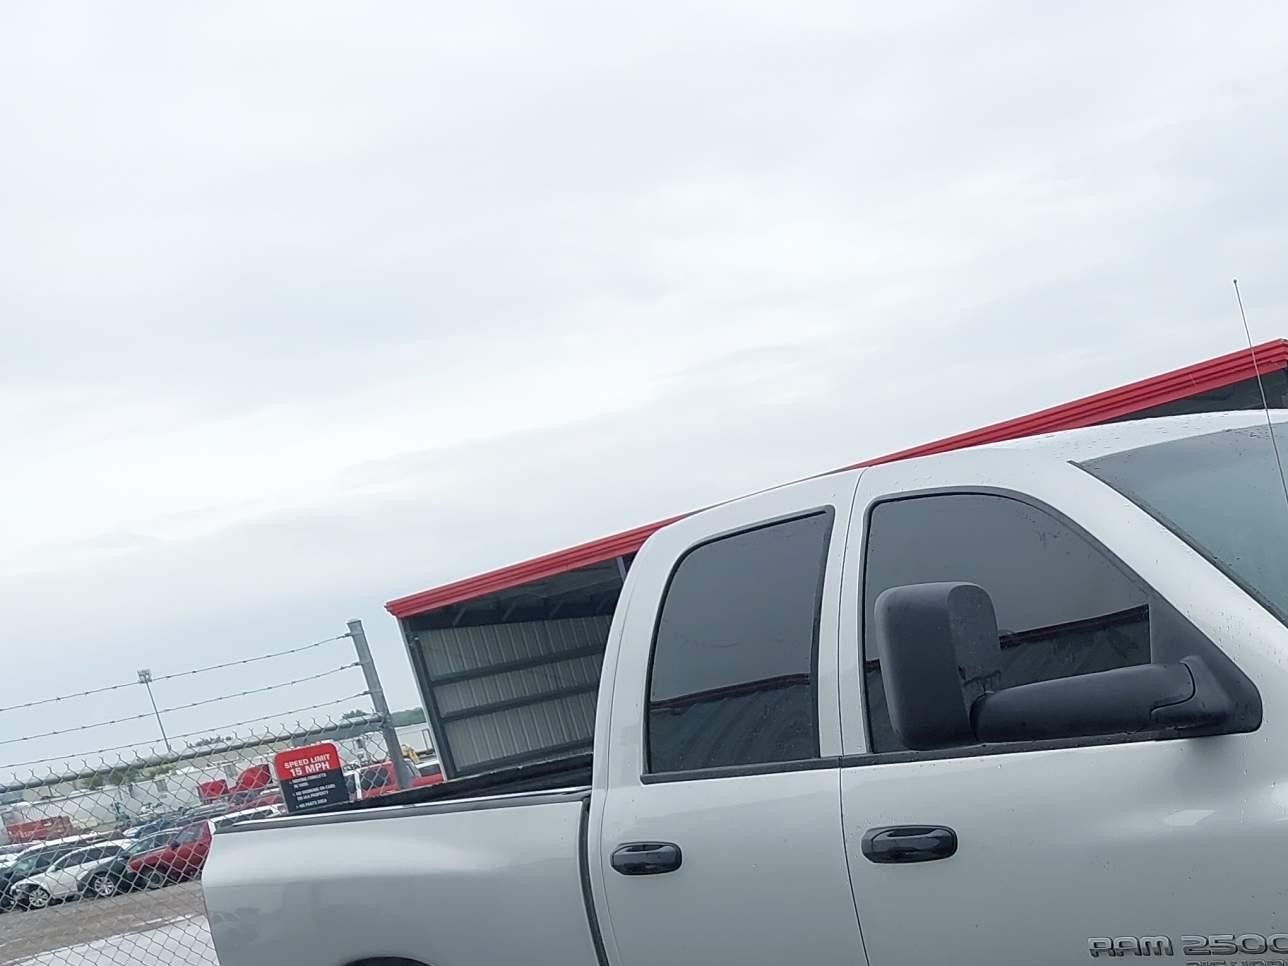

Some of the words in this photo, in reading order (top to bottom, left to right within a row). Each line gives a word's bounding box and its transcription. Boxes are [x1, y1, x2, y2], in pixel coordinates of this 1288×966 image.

[284, 759, 309, 769] SPEED
[310, 754, 330, 763] LIMIT
[290, 767, 303, 777] 15
[305, 761, 330, 774] MPH
[1087, 936, 1174, 957] RAM
